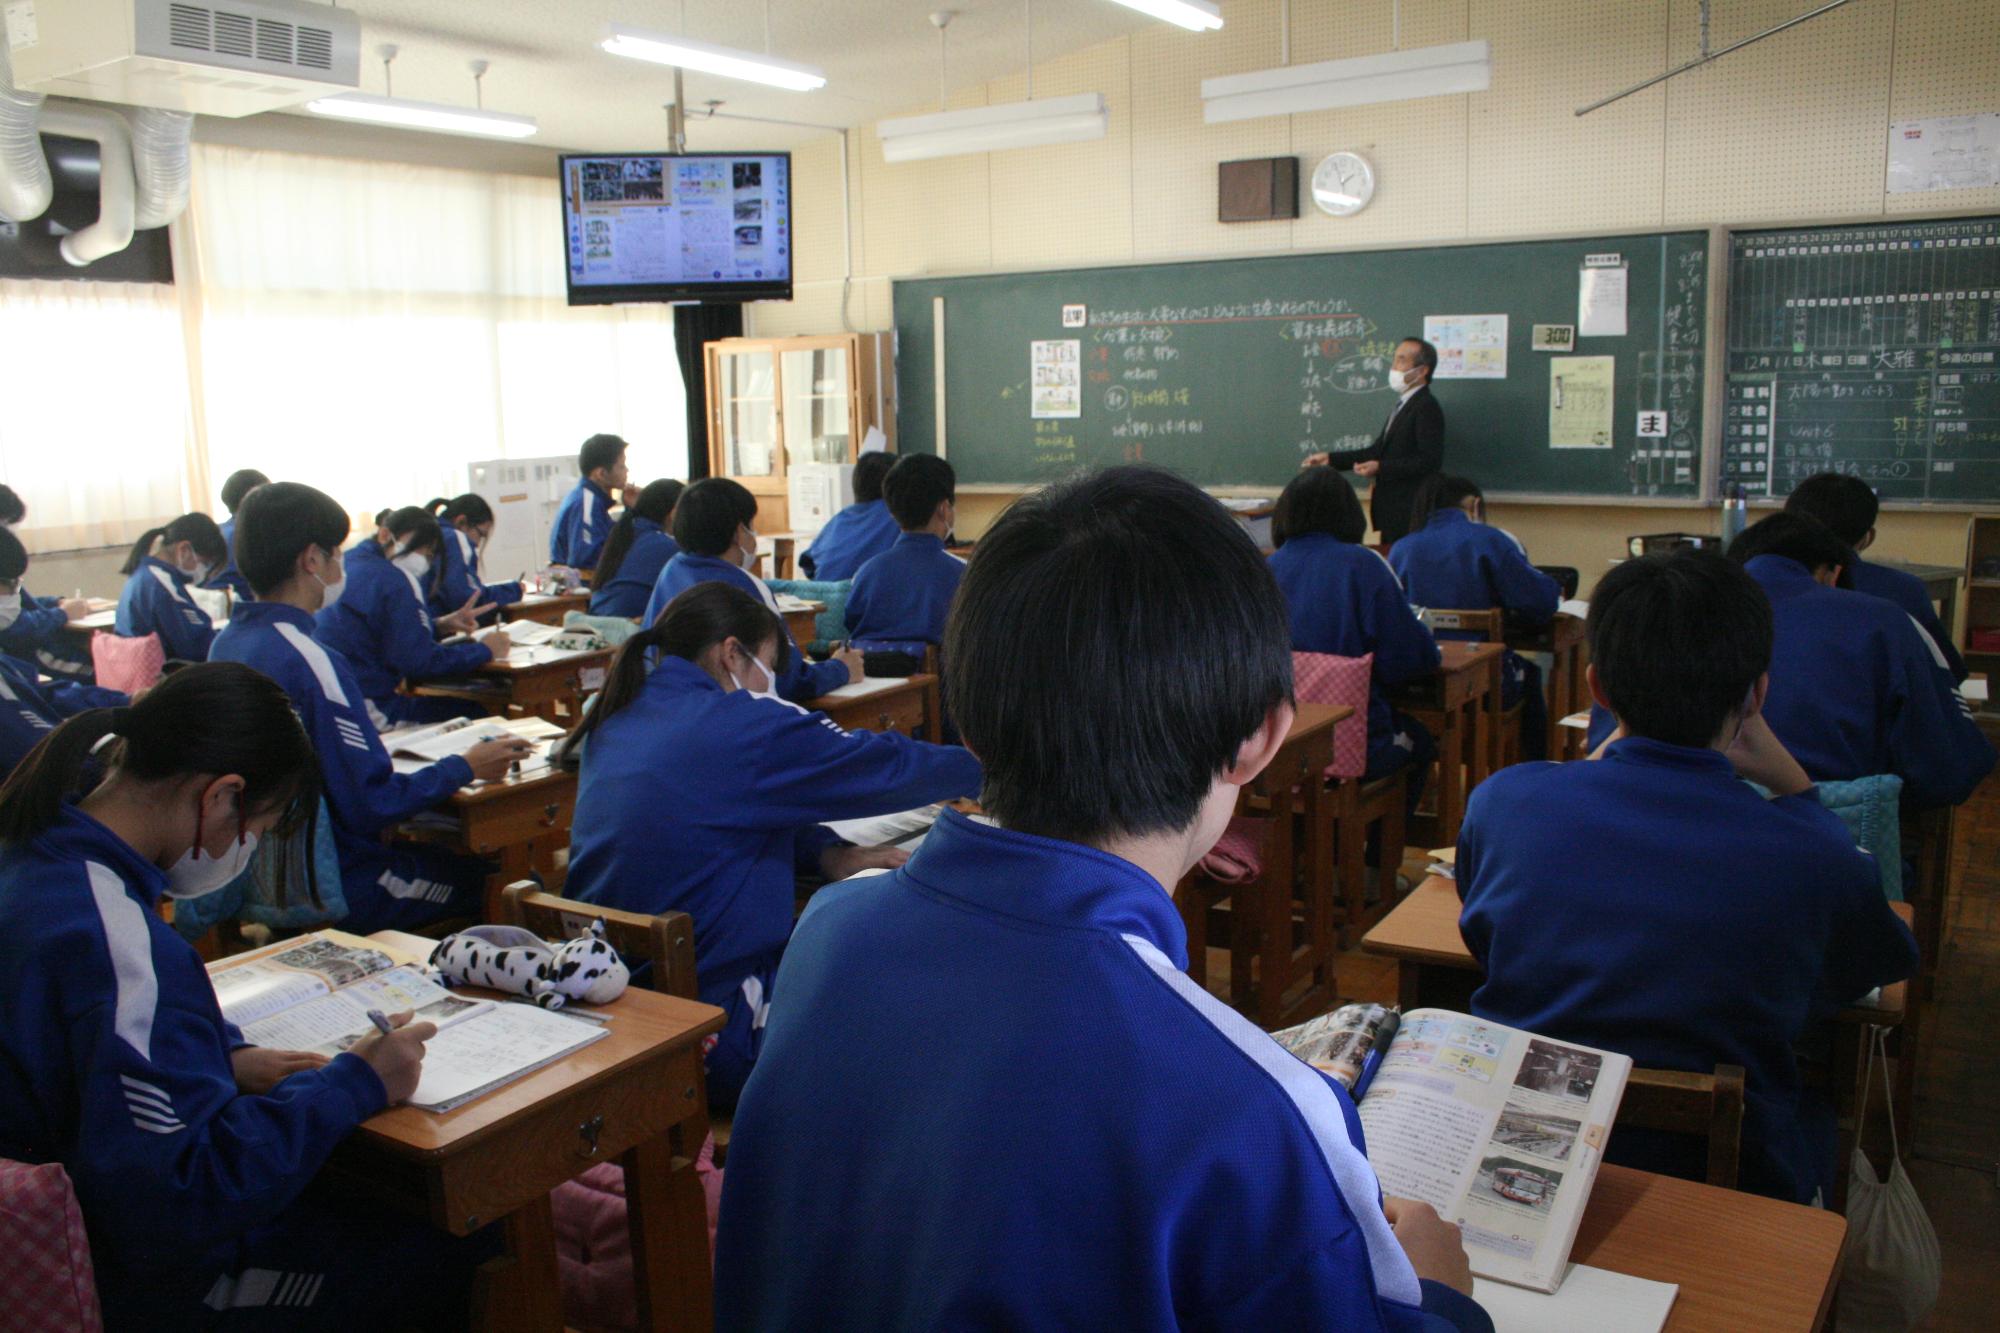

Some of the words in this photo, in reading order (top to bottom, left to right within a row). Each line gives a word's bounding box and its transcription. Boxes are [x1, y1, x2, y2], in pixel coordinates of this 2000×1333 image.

[1799, 234, 1809, 243] 25
[1810, 233, 1819, 243] 24
[1821, 233, 1830, 242] 23
[1832, 232, 1841, 241] 22
[1844, 231, 1853, 241] 21
[1855, 231, 1864, 240] 20
[1867, 230, 1876, 240] 19
[1878, 230, 1887, 239] 18
[1890, 229, 1898, 239] 17
[1901, 229, 1910, 238] 16
[1912, 228, 1922, 238] 15
[1925, 227, 1934, 237] 14
[1936, 226, 1946, 236] 13
[1948, 226, 1958, 235] 12
[1961, 225, 1970, 235] 11
[1973, 224, 1982, 234] 10
[1987, 223, 1993, 233] 9
[1940, 352, 1994, 364] 今週の目標
[1741, 405, 1768, 416] 社会
[1641, 415, 1661, 433] ま
[1935, 421, 1968, 433] 持ち物
